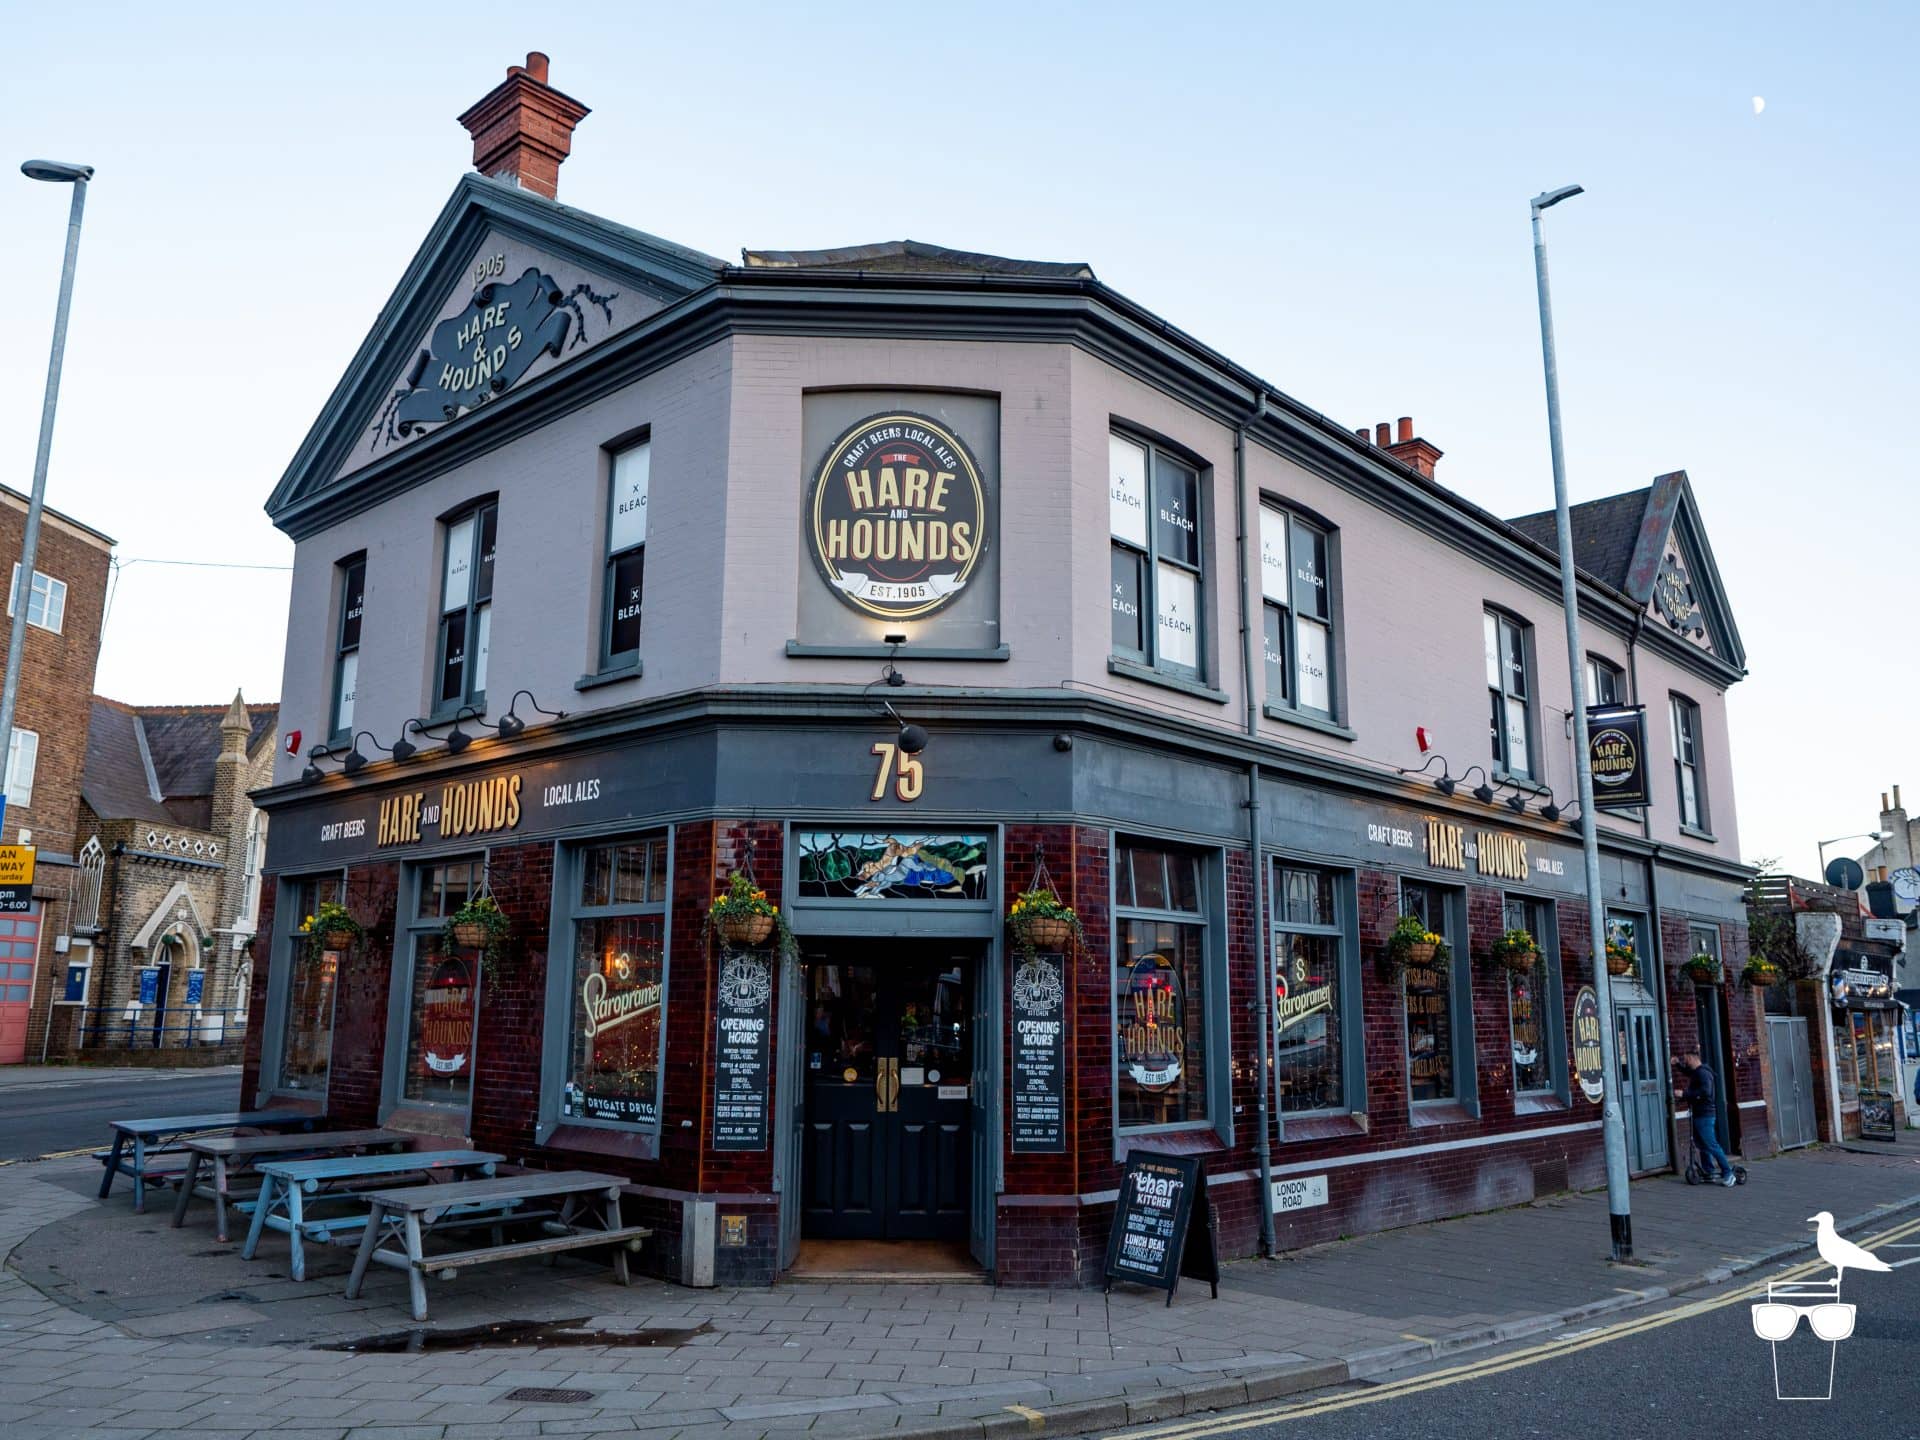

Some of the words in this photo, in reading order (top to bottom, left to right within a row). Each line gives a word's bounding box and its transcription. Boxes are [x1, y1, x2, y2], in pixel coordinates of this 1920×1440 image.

[471, 253, 505, 292] 1905
[457, 302, 510, 350] HARE
[438, 325, 522, 393] HOUNDS
[473, 334, 487, 362] &
[843, 440, 869, 467] CRAFT
[870, 427, 902, 444] BEERS
[904, 427, 938, 449] LOCAL
[935, 446, 957, 470] ALES
[893, 453, 907, 462] THE
[845, 467, 956, 512] HARE
[890, 508, 909, 519] AND
[1160, 509, 1194, 533] BLEACH
[826, 518, 973, 562] HOUNDS
[1297, 568, 1324, 589] BLEACH
[1159, 613, 1192, 634] BLEACH
[1596, 743, 1628, 758] HARE
[871, 743, 923, 801] 75
[1592, 756, 1634, 773] HOUNDS
[543, 785, 574, 808] LOCAL
[574, 778, 602, 803] ALES
[378, 792, 424, 846] HARE
[421, 805, 440, 826] AND
[440, 774, 522, 837] HOUNDS
[320, 822, 344, 843] CRAFT
[343, 819, 367, 839] BEERS
[1368, 823, 1391, 844] CRAFT
[1392, 829, 1414, 848] BEERS
[1427, 822, 1466, 871] HARE
[1464, 841, 1478, 860] AND
[1477, 831, 1529, 881] HOUNDS
[1535, 857, 1553, 874] LOCAL
[1551, 859, 1565, 876] ALES
[583, 972, 663, 1038] Staropramen
[1133, 988, 1176, 1020] HARE
[425, 1021, 471, 1046] HOUNDS
[720, 1017, 764, 1031] OPENING
[1017, 1020, 1060, 1034] OPENING
[728, 1031, 759, 1044] HOURS
[1023, 1033, 1054, 1046] HOURS
[1127, 1025, 1184, 1054] HOUNDS
[588, 1097, 626, 1113] DRYGATE
[1276, 1179, 1307, 1197] LONDON
[1136, 1193, 1172, 1209] KITCHEN
[1282, 1194, 1303, 1209] ROAD
[1124, 1233, 1148, 1248] LUNCH
[1148, 1237, 1165, 1252] DEAL
